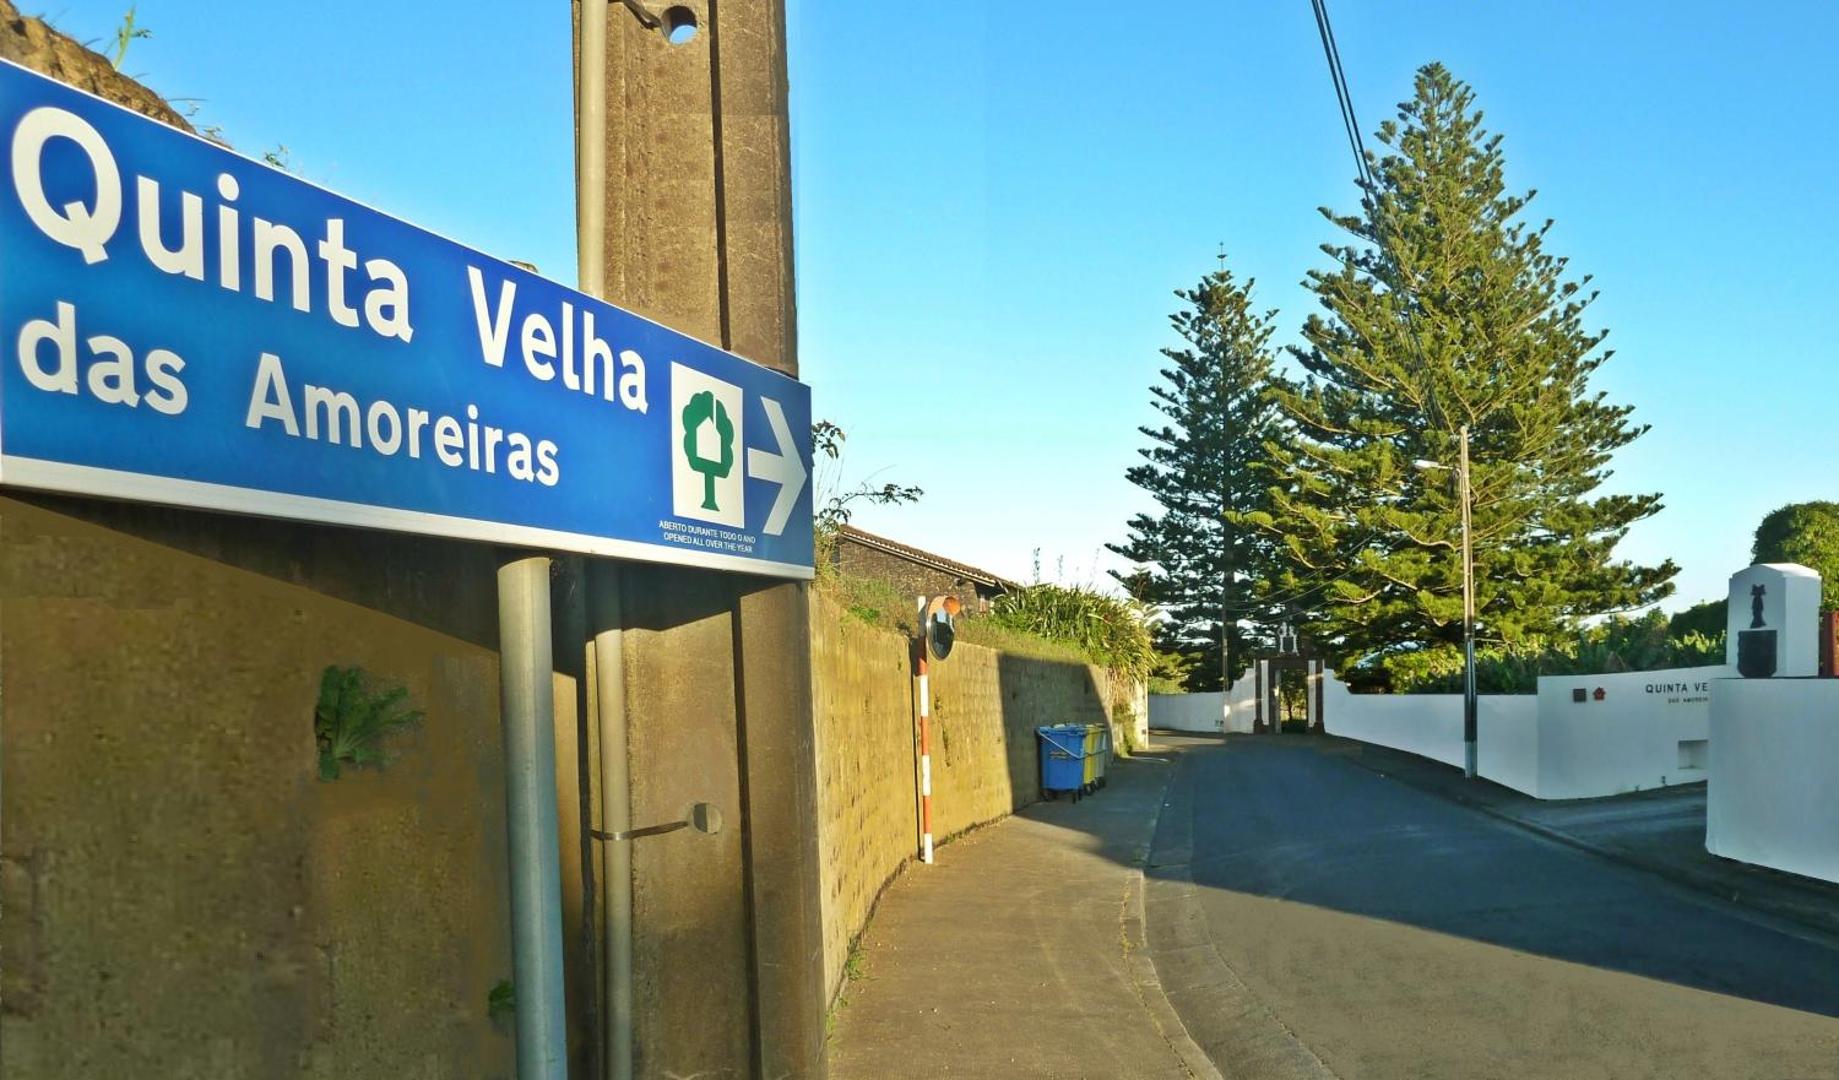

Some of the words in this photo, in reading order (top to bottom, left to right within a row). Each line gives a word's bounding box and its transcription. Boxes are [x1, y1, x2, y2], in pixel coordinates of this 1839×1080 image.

[12, 106, 414, 344] Quinta
[467, 265, 649, 415] Velha
[18, 301, 188, 416] das
[245, 352, 559, 487] Amoreiras
[659, 520, 687, 532] ABERTO
[688, 525, 718, 538] DURANTE
[719, 530, 737, 541] TODO
[743, 535, 756, 544] ANO
[663, 531, 691, 544] OPENED
[692, 536, 706, 547] ALL
[705, 538, 723, 549] OVER
[723, 541, 737, 551] THE
[737, 543, 753, 553] YEAR
[1645, 683, 1688, 694] QUINTA
